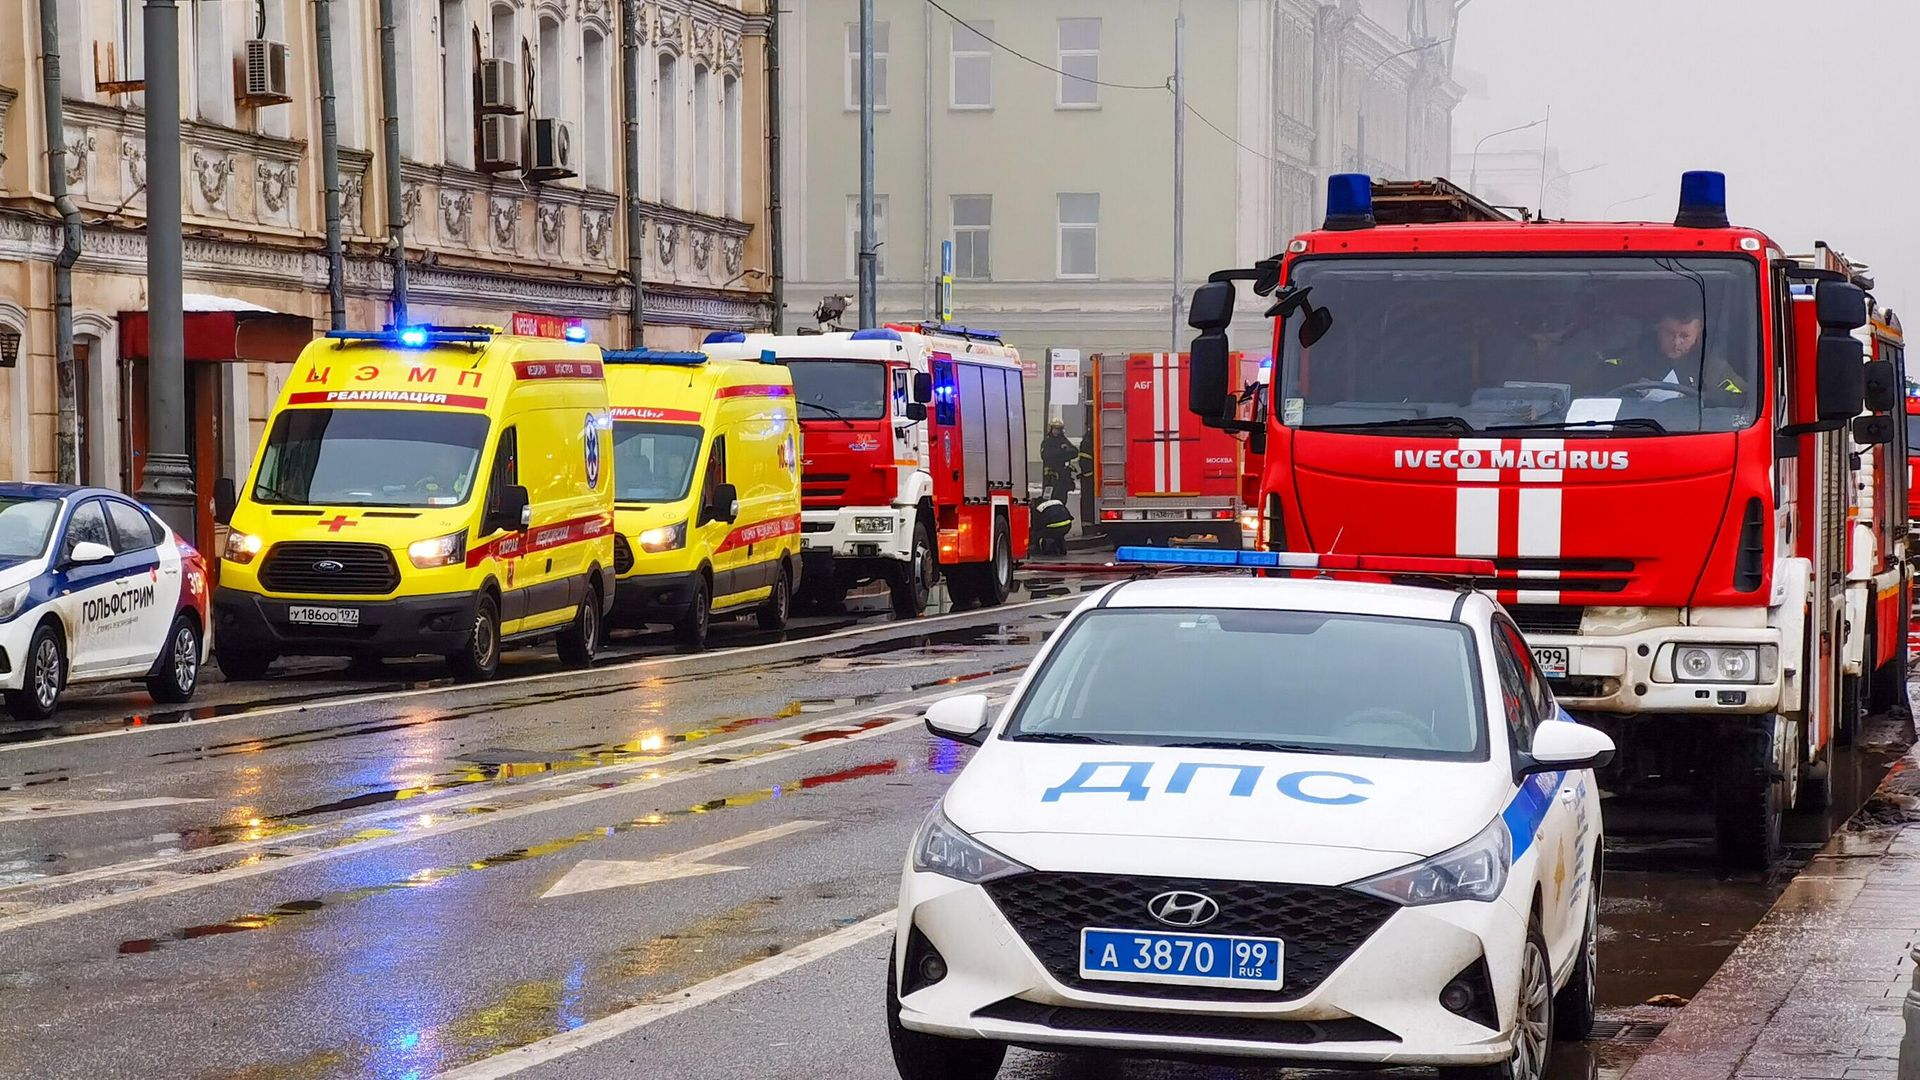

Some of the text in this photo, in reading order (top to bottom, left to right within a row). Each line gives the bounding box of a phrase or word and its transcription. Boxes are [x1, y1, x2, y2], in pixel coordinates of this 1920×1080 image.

[1134, 381, 1152, 389] АБГ
[327, 391, 447, 404] РЕАНИМАЦИЯ
[1394, 450, 1629, 469] IVECO MAGIRUS
[82, 585, 154, 624] ГОЛЬФСТРИМ
[339, 610, 356, 619] 197
[1534, 650, 1562, 664] 199
[1040, 761, 1375, 805] ДПС
[1100, 938, 1267, 973] А 3870 99
[1239, 967, 1263, 977] RUS
